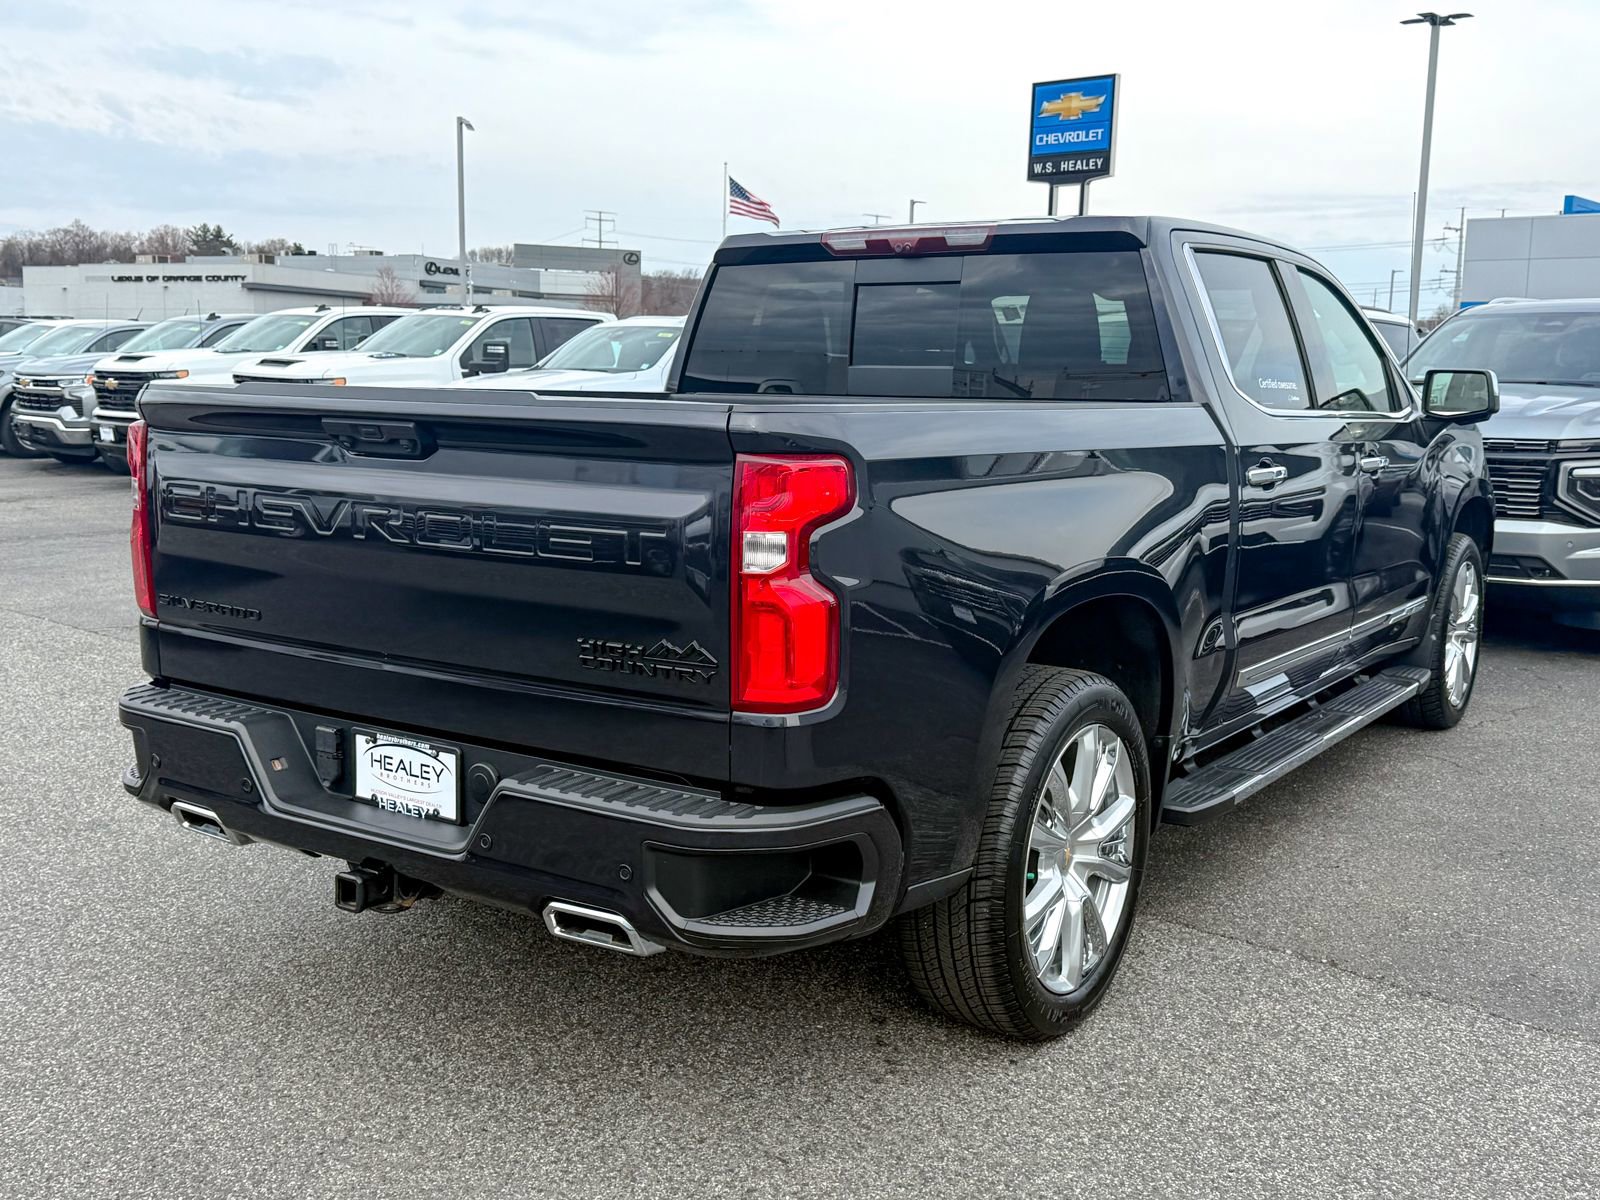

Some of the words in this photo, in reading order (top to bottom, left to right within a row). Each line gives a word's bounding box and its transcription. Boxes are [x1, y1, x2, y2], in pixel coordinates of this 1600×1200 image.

[1035, 129, 1104, 146] CHEVROLET
[1033, 162, 1056, 174] W.S.
[1060, 158, 1103, 172] HEALEY
[165, 482, 668, 566] CHEVROLET
[577, 637, 646, 657] HIGH
[579, 654, 717, 684] COUNTRY
[370, 752, 444, 783] HEALEY
[380, 772, 431, 789] BROTHERS
[378, 797, 428, 819] HEALEY
